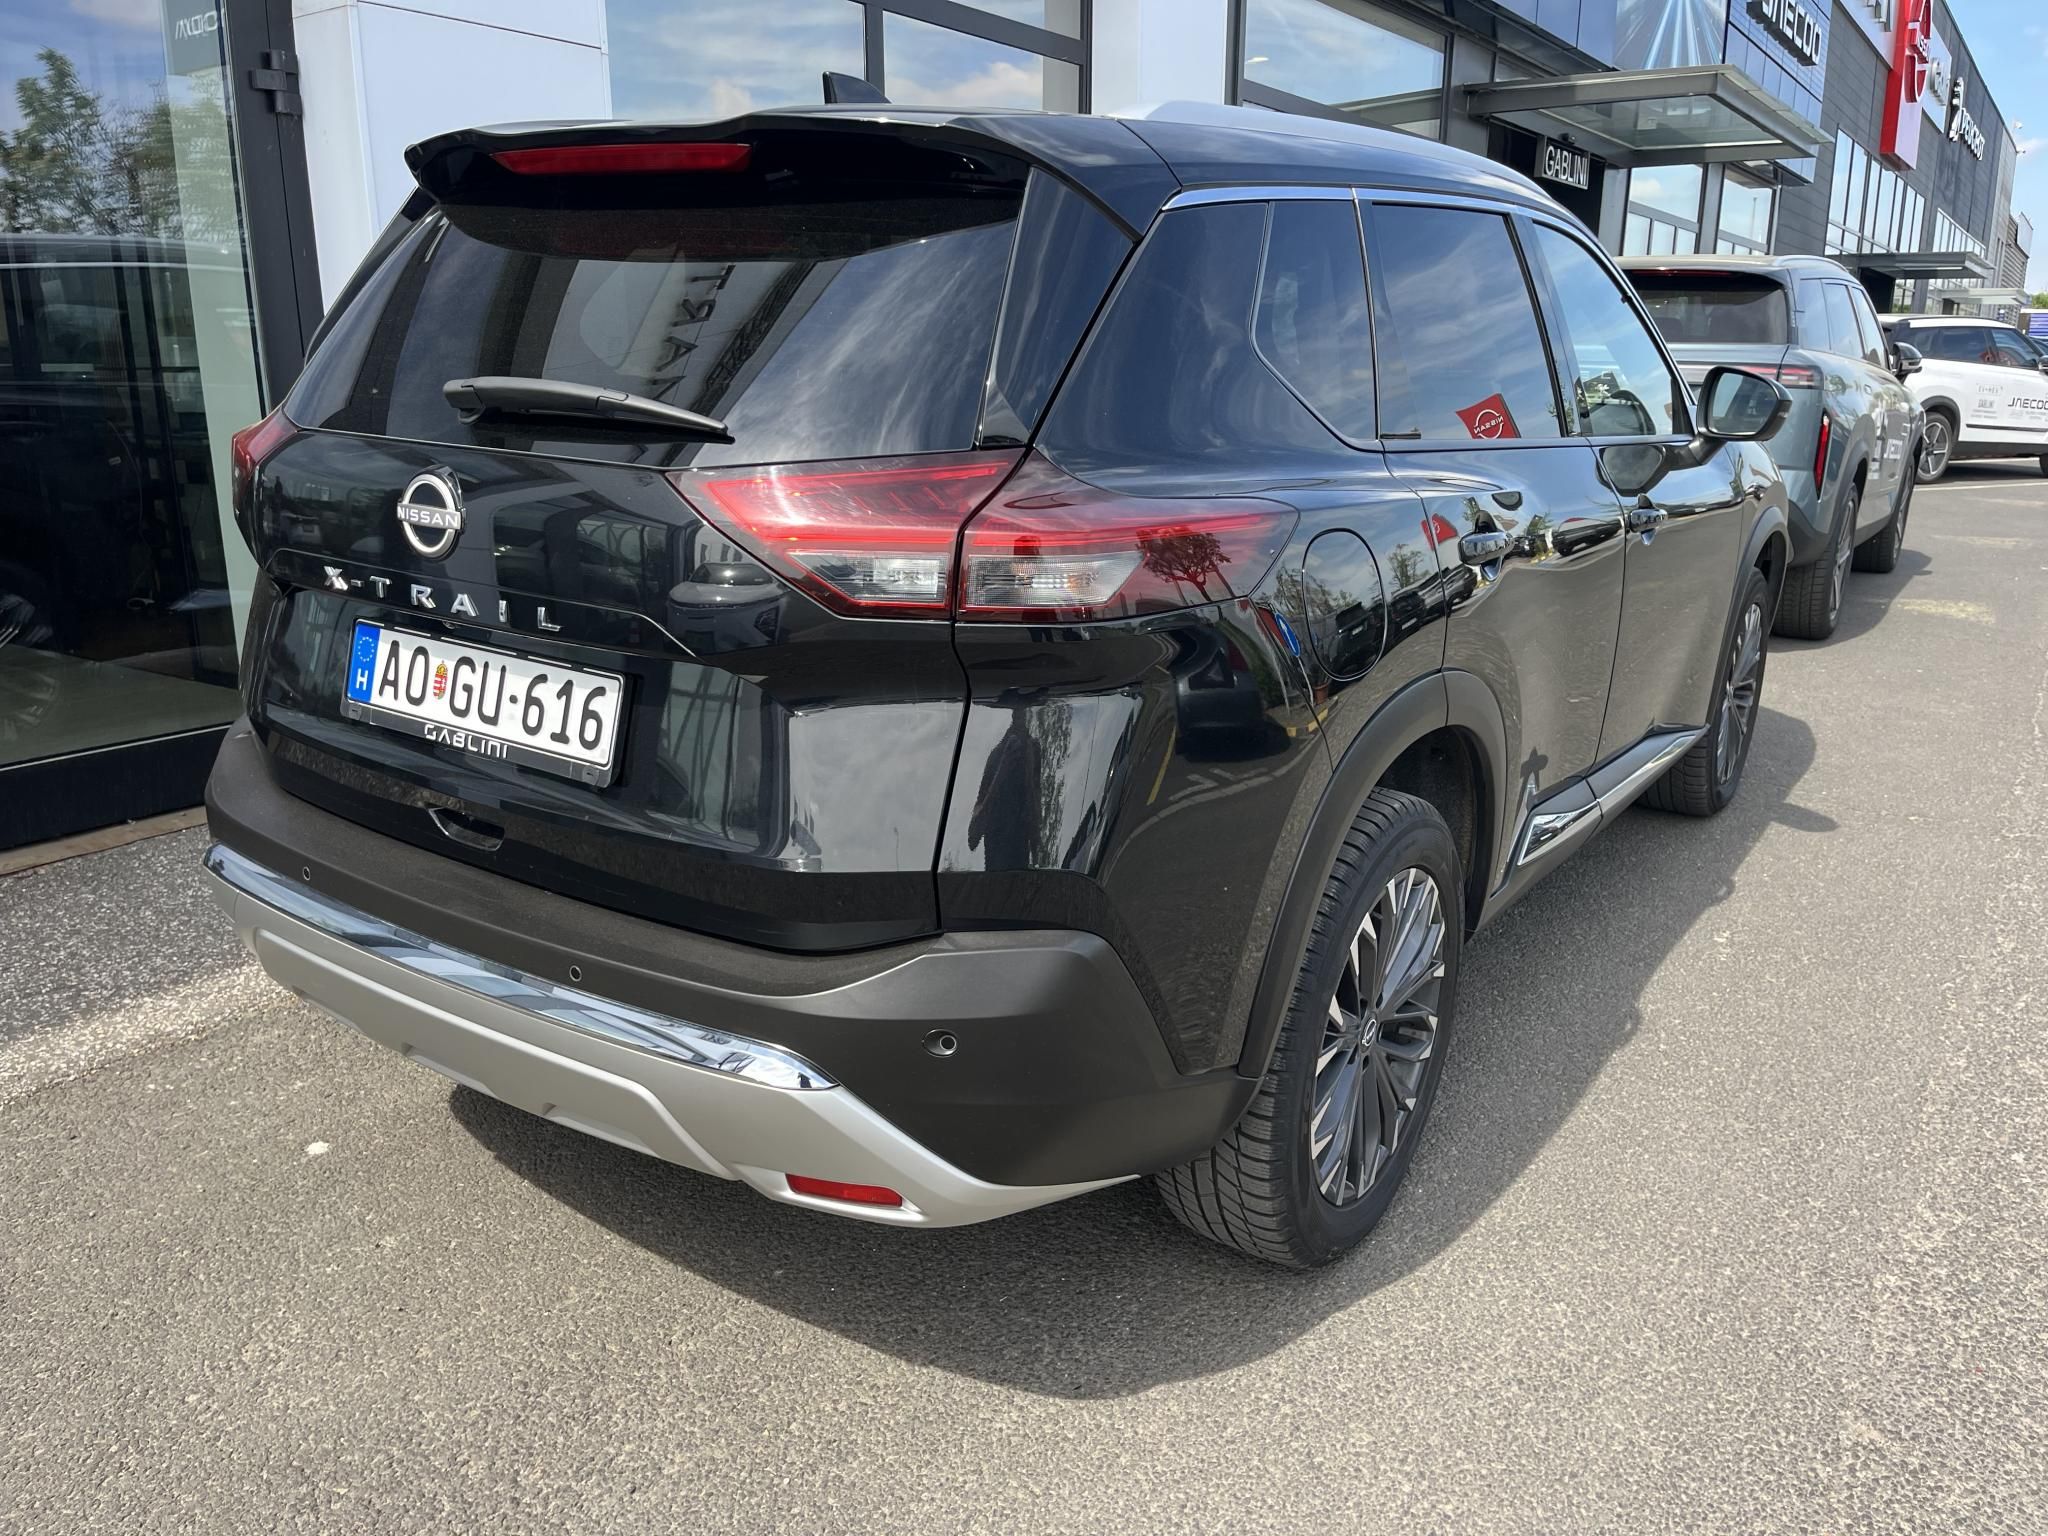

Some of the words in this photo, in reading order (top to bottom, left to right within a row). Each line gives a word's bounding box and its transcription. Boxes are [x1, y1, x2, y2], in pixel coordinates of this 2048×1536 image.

[1545, 145, 1588, 186] GABLINI
[397, 505, 458, 528] NISSAN
[323, 565, 562, 632] X-TRAIL
[355, 668, 369, 691] H
[378, 639, 430, 706] AO
[423, 723, 509, 759] GABLINI
